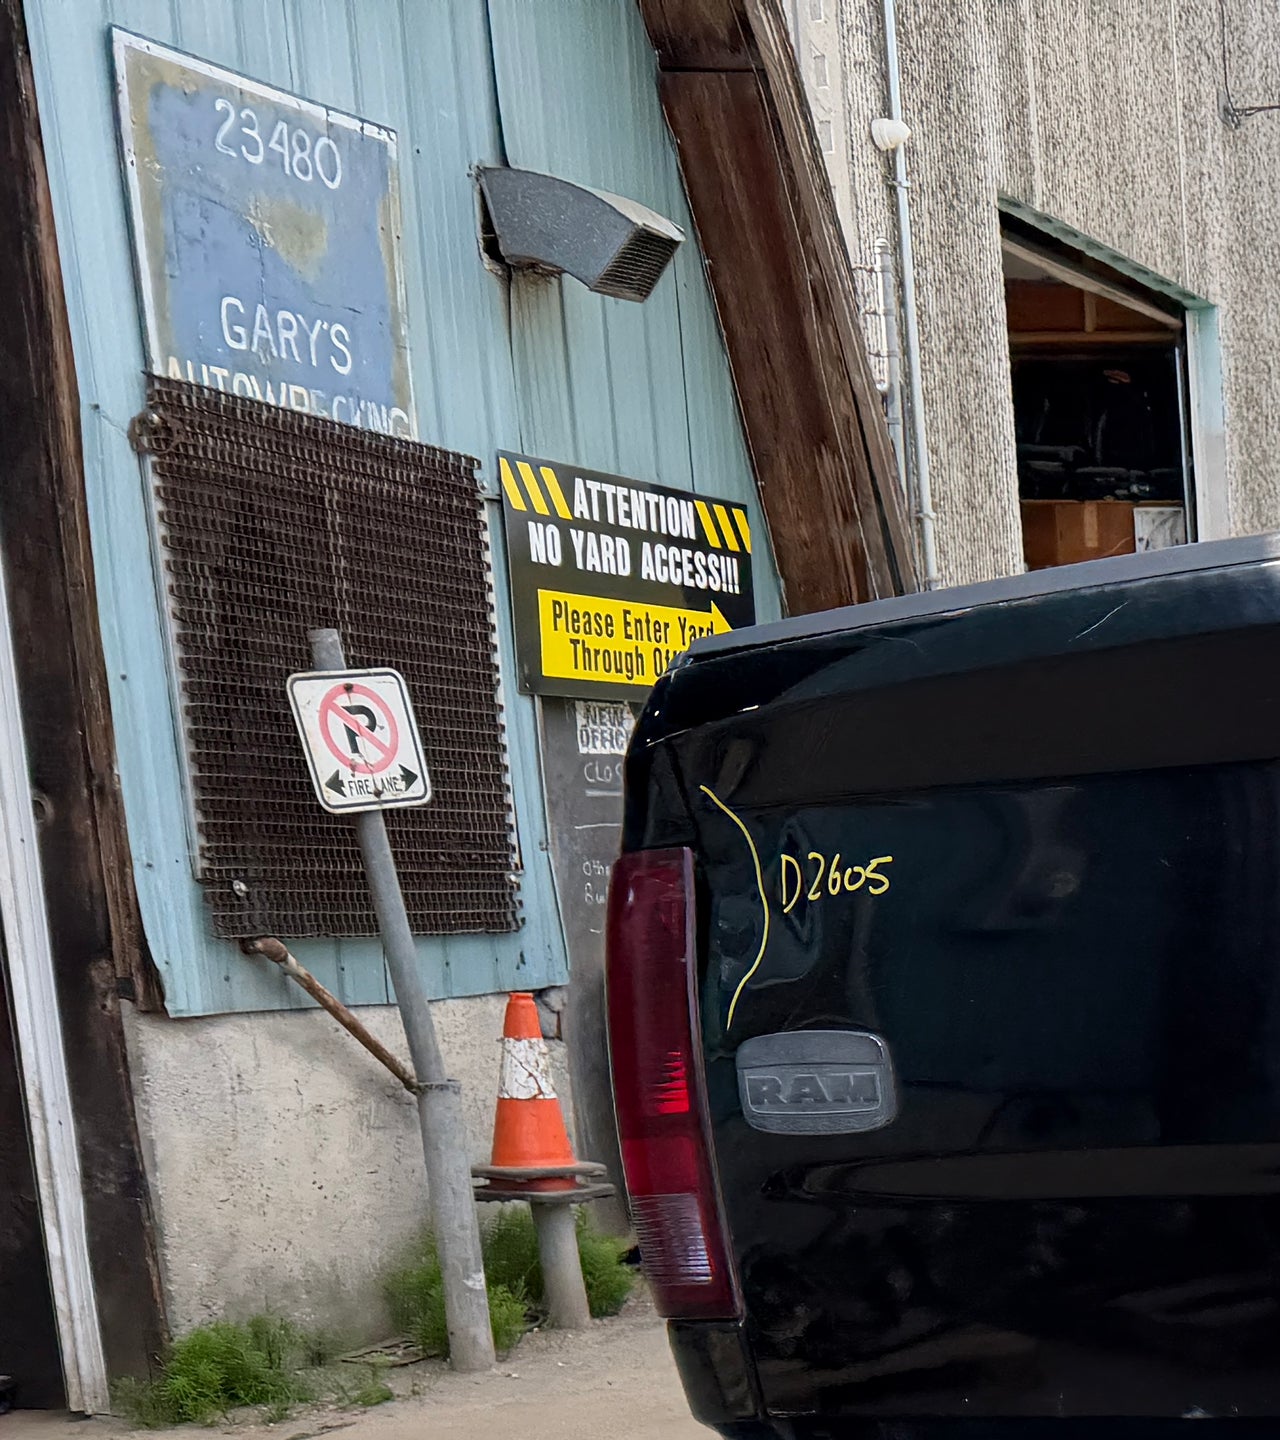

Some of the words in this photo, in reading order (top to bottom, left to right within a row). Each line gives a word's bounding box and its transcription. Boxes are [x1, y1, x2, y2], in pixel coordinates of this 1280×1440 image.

[214, 98, 342, 190] 23480
[220, 296, 352, 376] GARY'S
[573, 477, 697, 541] ATTENTION
[527, 520, 562, 567] NO
[570, 529, 631, 577] YARD
[641, 541, 741, 595] ACCESS!!!
[552, 599, 615, 639] Please
[622, 608, 670, 644] Enter
[569, 638, 646, 681] Through
[580, 727, 629, 751] OFFIC
[348, 779, 373, 797] FIRE
[780, 851, 893, 913] D2605
[746, 1072, 881, 1105] RAM
